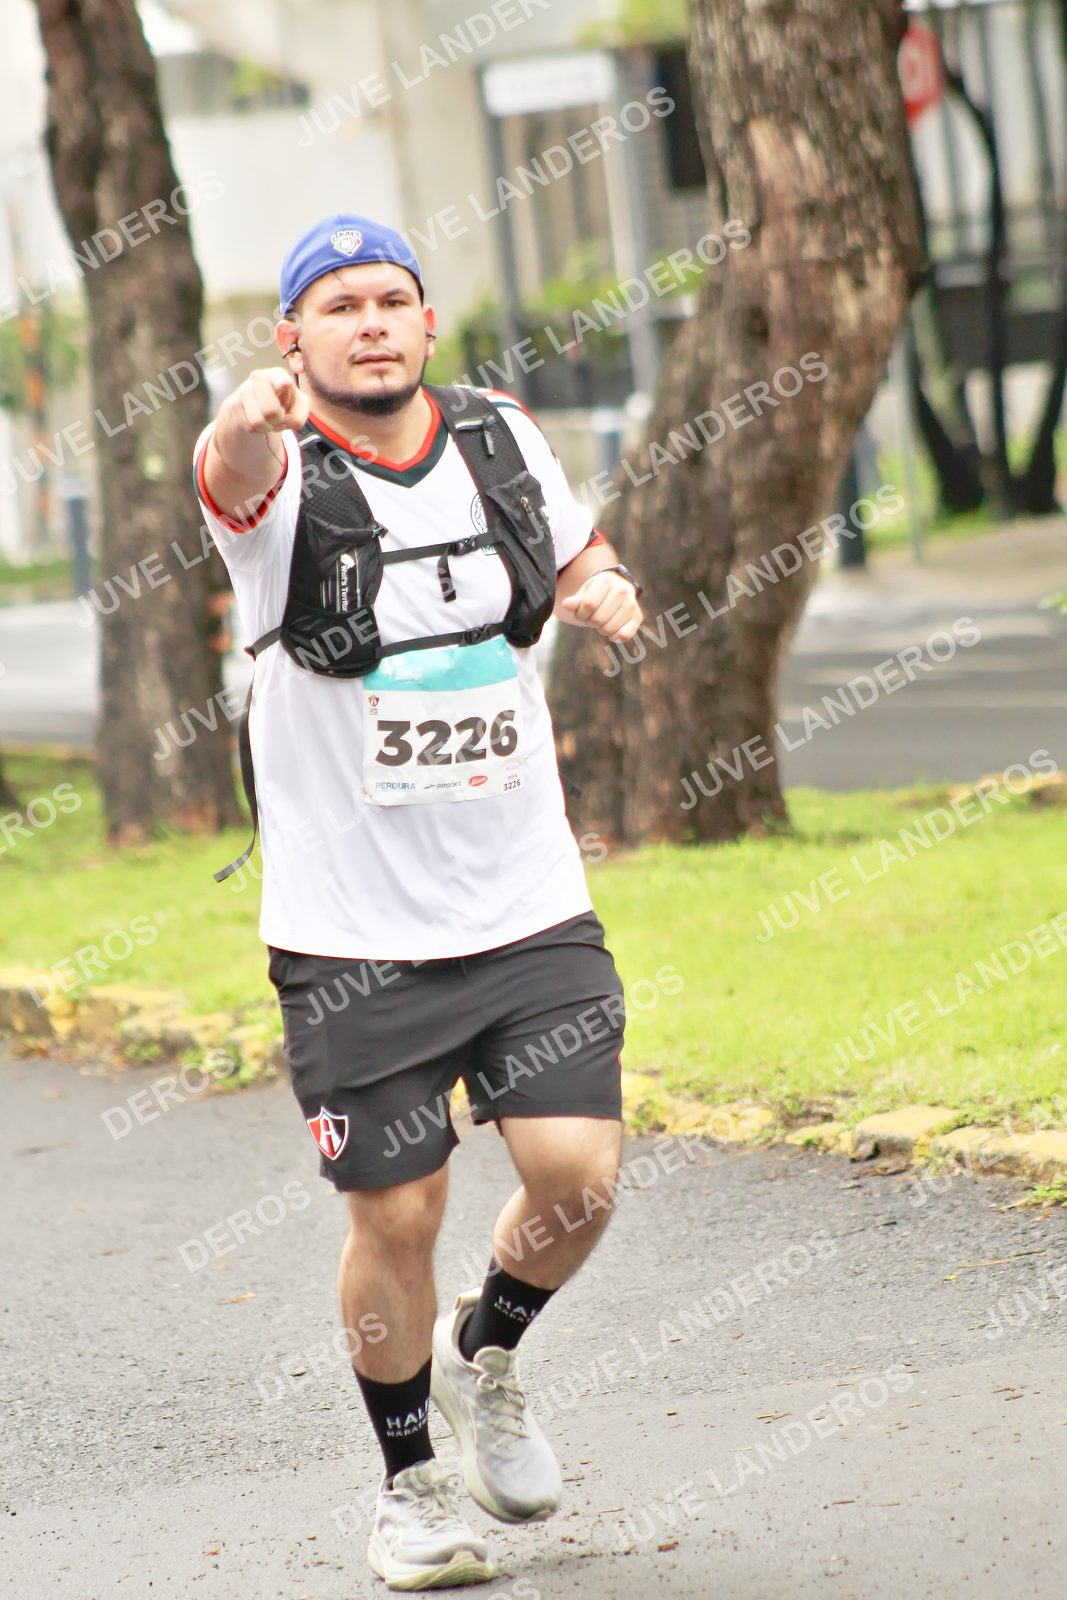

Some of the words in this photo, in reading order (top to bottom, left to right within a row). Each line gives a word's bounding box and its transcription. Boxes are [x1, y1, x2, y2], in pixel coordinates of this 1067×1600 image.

[375, 710, 518, 767] 3226
[375, 782, 416, 790] PERDURA
[503, 779, 521, 791] 3226
